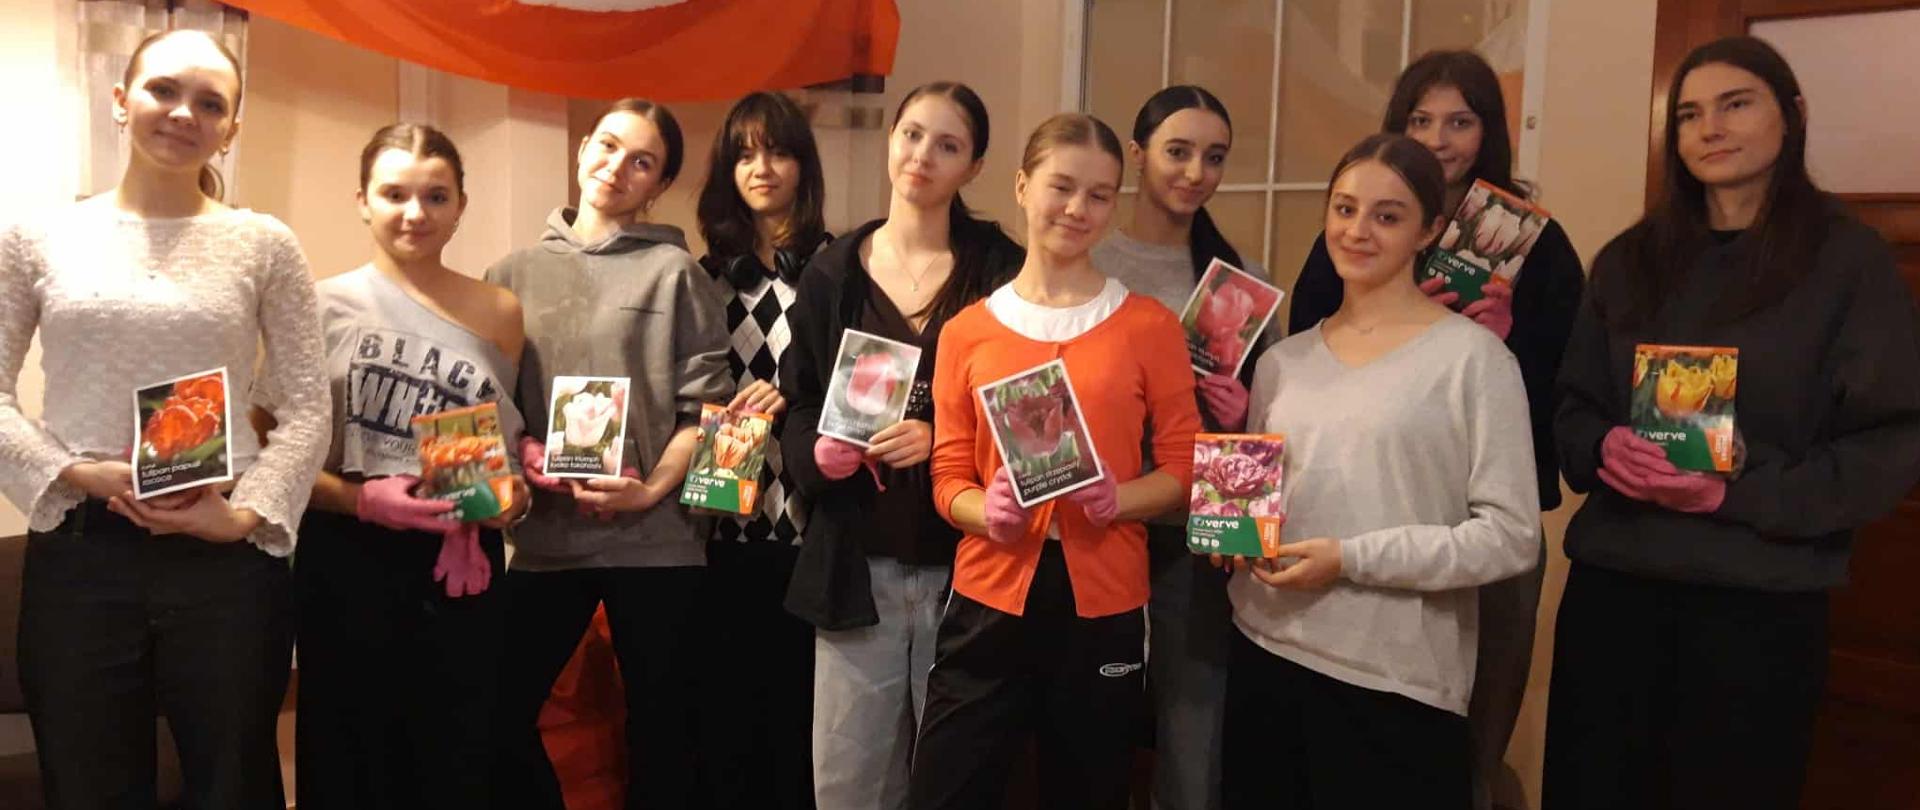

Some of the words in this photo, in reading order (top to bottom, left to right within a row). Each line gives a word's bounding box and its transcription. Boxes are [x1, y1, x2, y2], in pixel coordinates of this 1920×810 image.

[1447, 256, 1476, 276] verve
[1648, 431, 1687, 441] verve
[700, 476, 725, 488] verve
[1023, 480, 1048, 496] purple
[1205, 519, 1239, 529] verve
